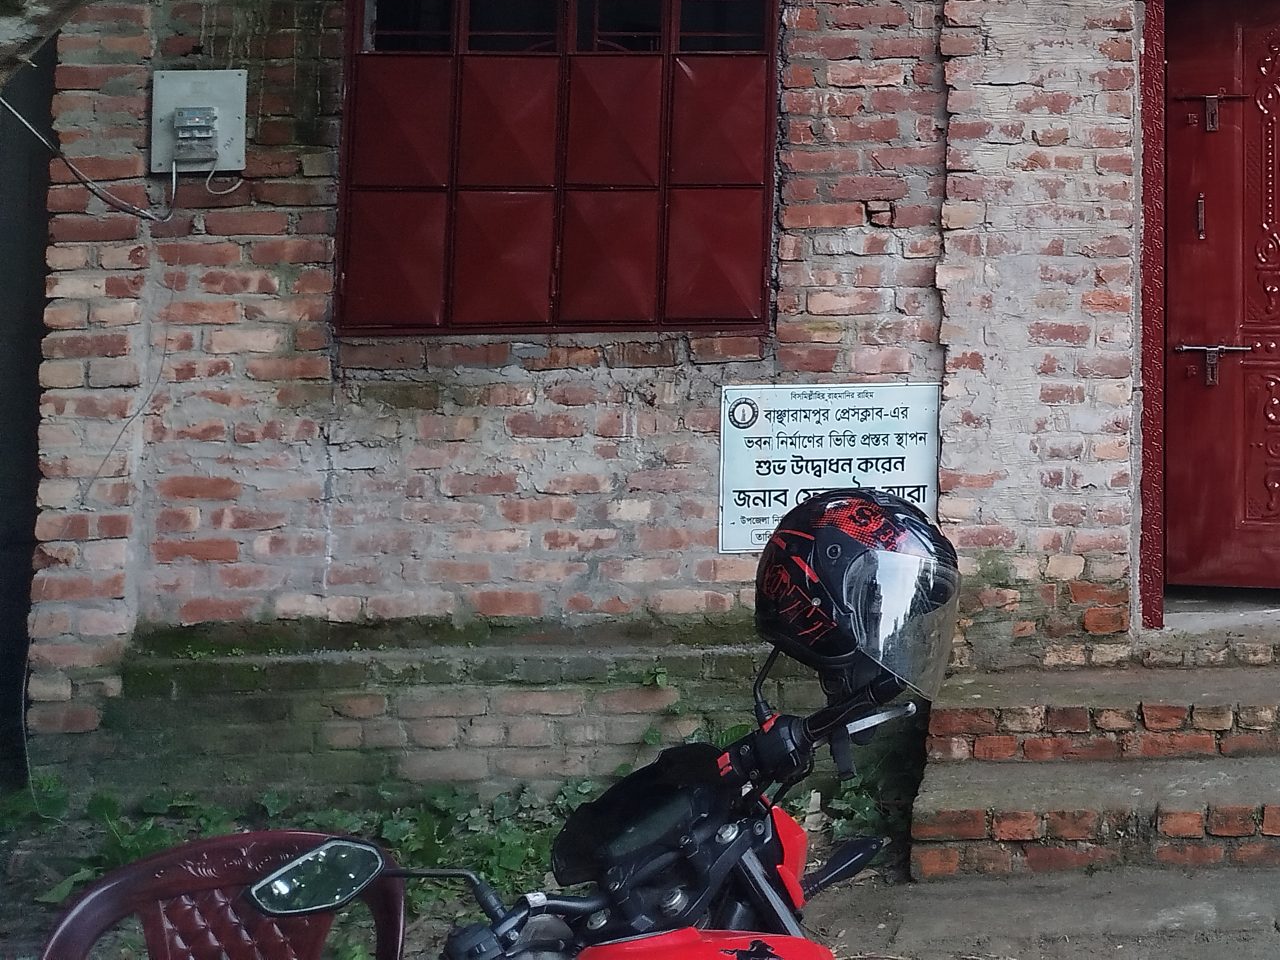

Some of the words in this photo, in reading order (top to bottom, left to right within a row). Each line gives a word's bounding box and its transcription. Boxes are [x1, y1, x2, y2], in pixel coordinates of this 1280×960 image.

[763, 407, 830, 428] বাঞ্ছারামপুর
[835, 405, 910, 423] প্রেসক্লাব-এর
[744, 436, 773, 451] ভবন
[776, 430, 826, 450] নির্মাণের
[828, 429, 858, 449] ভিত্তি
[860, 433, 891, 448] প্রস্তর
[894, 431, 929, 449] স্থাপন
[755, 459, 788, 476] শুভ
[790, 454, 854, 478] উদ্বোধন
[857, 456, 907, 474] করেন
[732, 488, 789, 509] জনাব
[740, 515, 770, 525] উপজেলা
